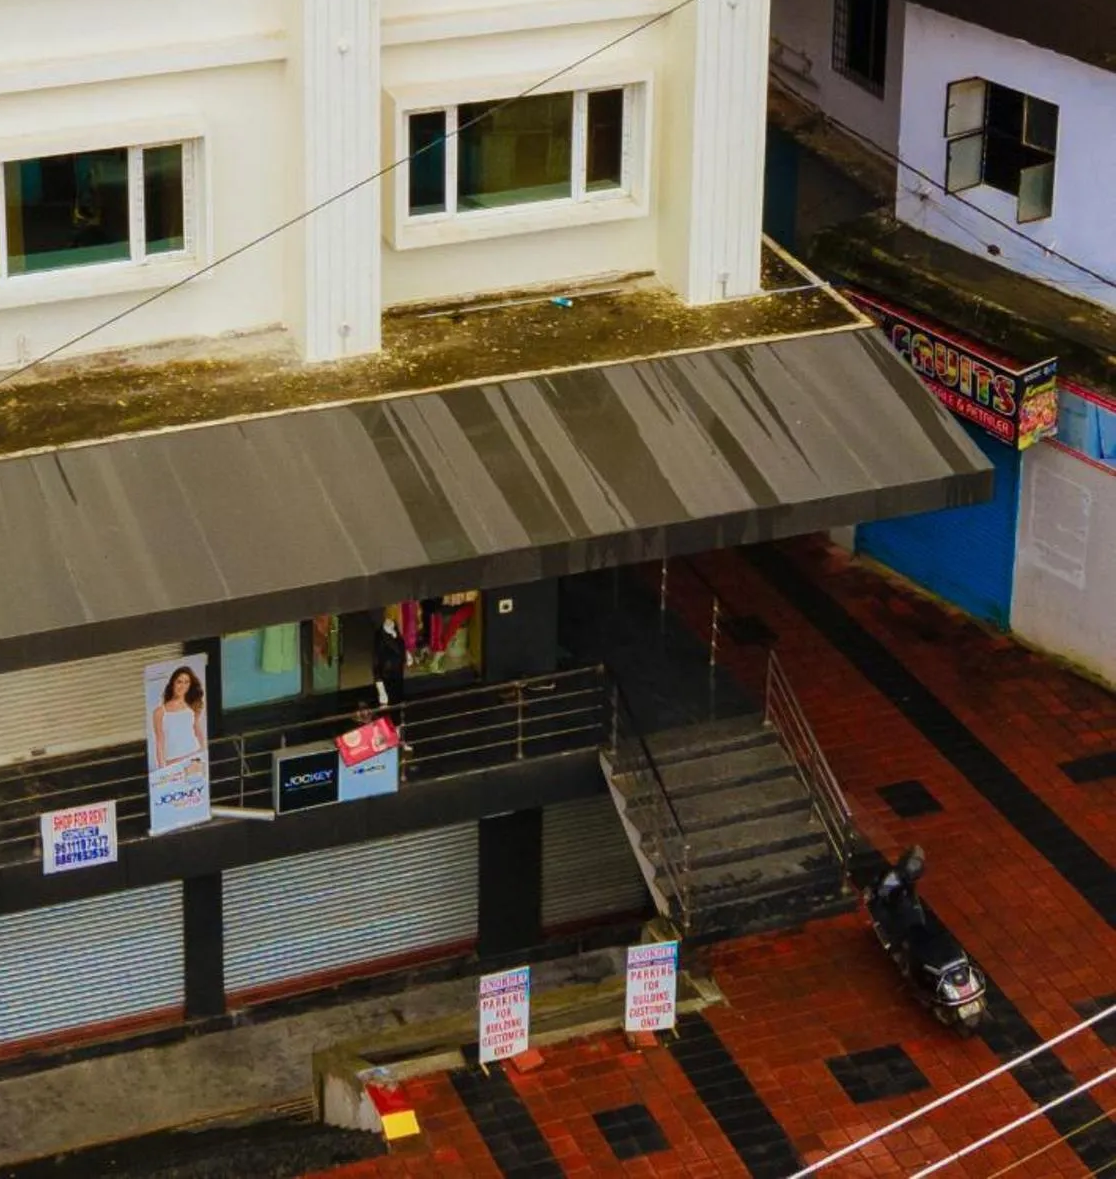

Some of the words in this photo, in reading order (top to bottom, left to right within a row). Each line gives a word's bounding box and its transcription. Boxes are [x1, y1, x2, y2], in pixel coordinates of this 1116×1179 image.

[284, 769, 333, 788] JOCKEY
[156, 786, 204, 806] JOCKEY
[89, 808, 107, 824] RENT
[630, 965, 673, 980] PARKING
[643, 980, 659, 990] FOR
[482, 994, 525, 1010] PARKING
[496, 1009, 512, 1019] FOR
[640, 1016, 660, 1029] ONLY
[482, 1030, 525, 1048] CUSTOMER
[493, 1044, 513, 1057] ONLY
